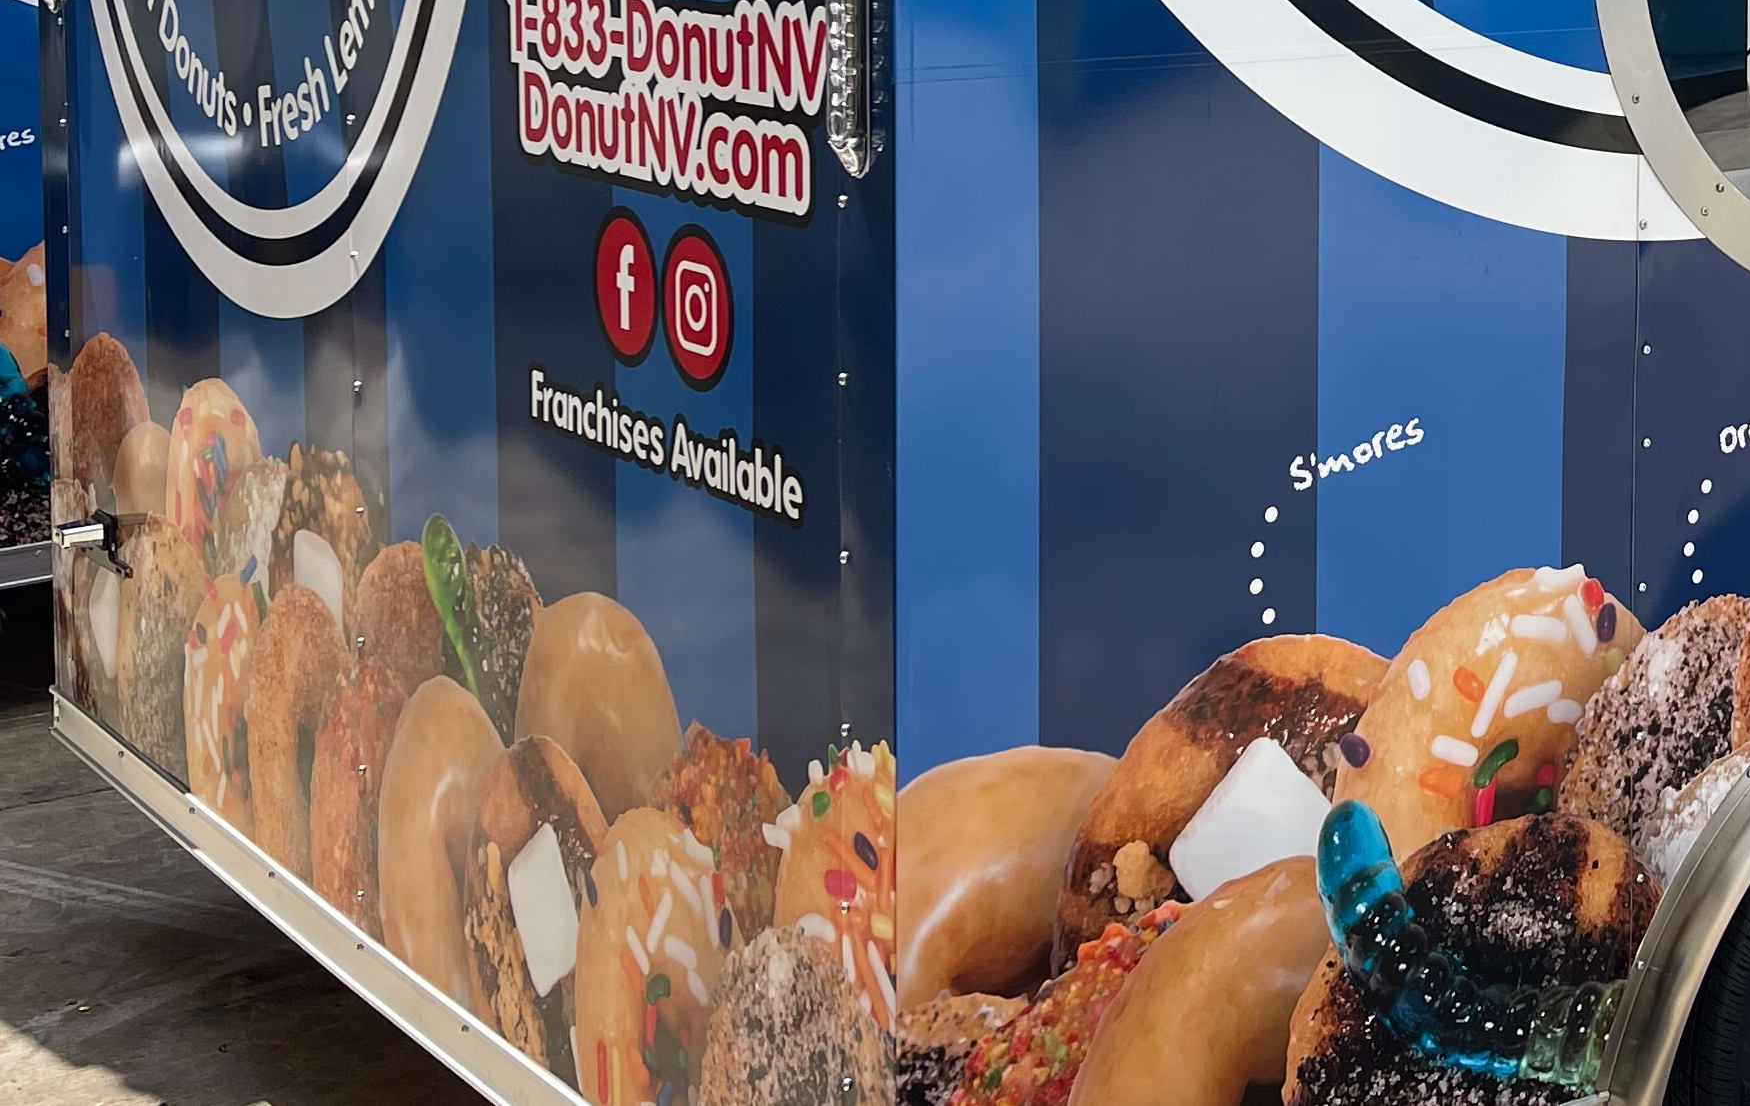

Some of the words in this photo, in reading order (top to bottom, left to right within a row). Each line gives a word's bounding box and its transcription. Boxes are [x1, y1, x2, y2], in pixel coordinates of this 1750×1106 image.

[258, 57, 330, 147] Fresh
[524, 70, 804, 202] DonutNV.com
[530, 369, 664, 466] Franchises
[671, 421, 803, 519] Available
[1289, 417, 1425, 491] S'mores
